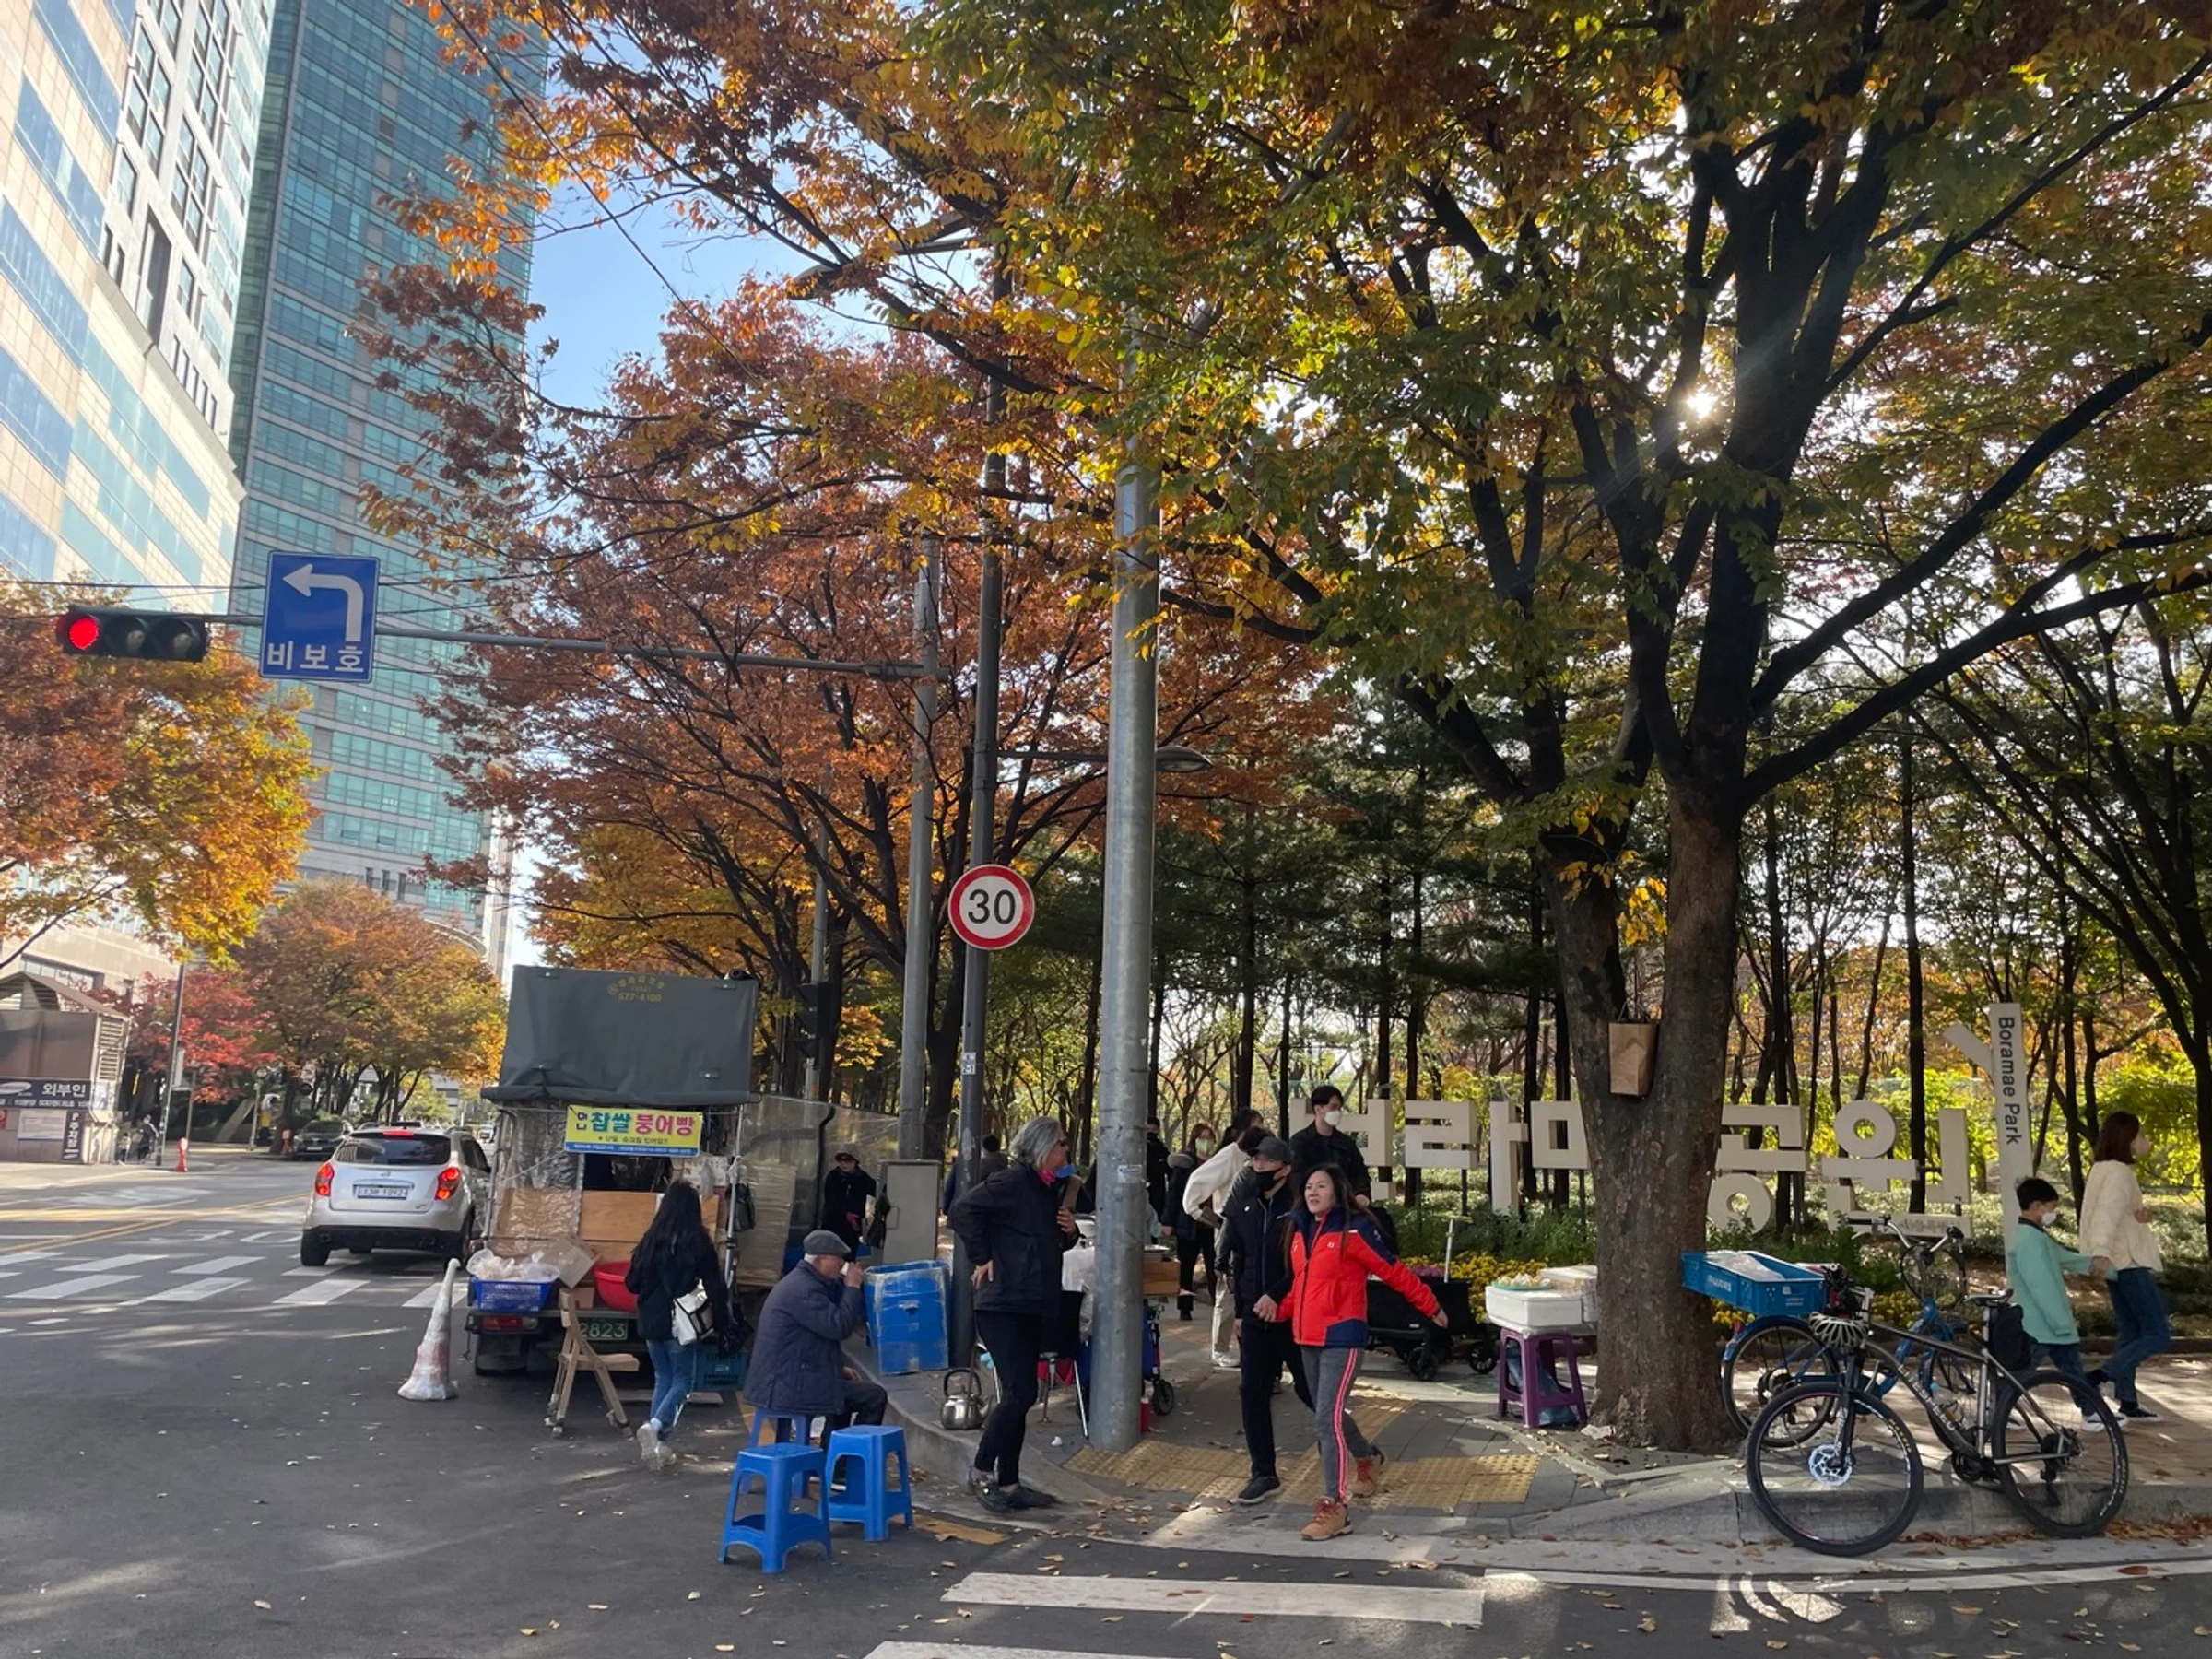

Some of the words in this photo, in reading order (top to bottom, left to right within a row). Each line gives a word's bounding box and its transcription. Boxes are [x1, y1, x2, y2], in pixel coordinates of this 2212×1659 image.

[267, 641, 364, 673] 비보호
[968, 888, 1016, 924] 30
[1998, 1017, 2016, 1097] Boramae
[41, 1083, 86, 1097] 외부인
[591, 1112, 631, 1134] 찹쌀
[635, 1113, 695, 1136] 붕어빵
[2004, 1103, 2022, 1145] Park
[1707, 1100, 1971, 1238] 공원
[580, 1323, 626, 1337] 2823
